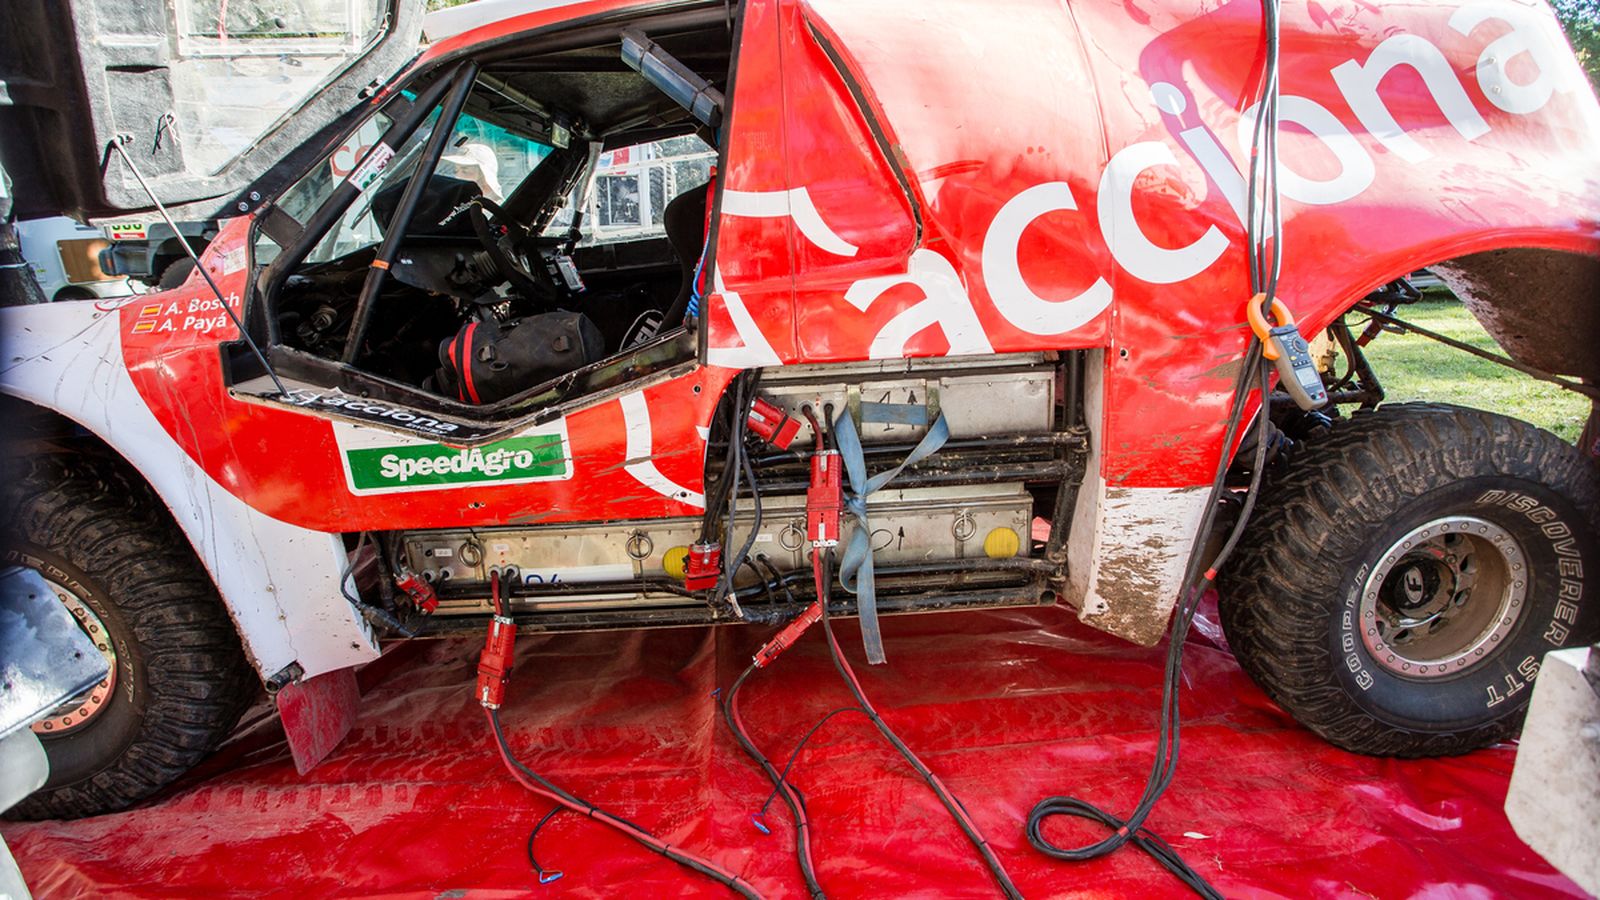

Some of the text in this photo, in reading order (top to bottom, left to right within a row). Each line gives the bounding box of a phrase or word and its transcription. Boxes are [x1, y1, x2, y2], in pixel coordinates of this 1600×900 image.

[845, 0, 1560, 359] acciona
[158, 312, 227, 333] A. Payá
[165, 302, 183, 315] A.
[323, 396, 460, 432] acciona
[380, 447, 533, 482] SpeedAgro
[1476, 489, 1584, 708] DISCOVERER STT
[1342, 563, 1374, 691] COOPER
